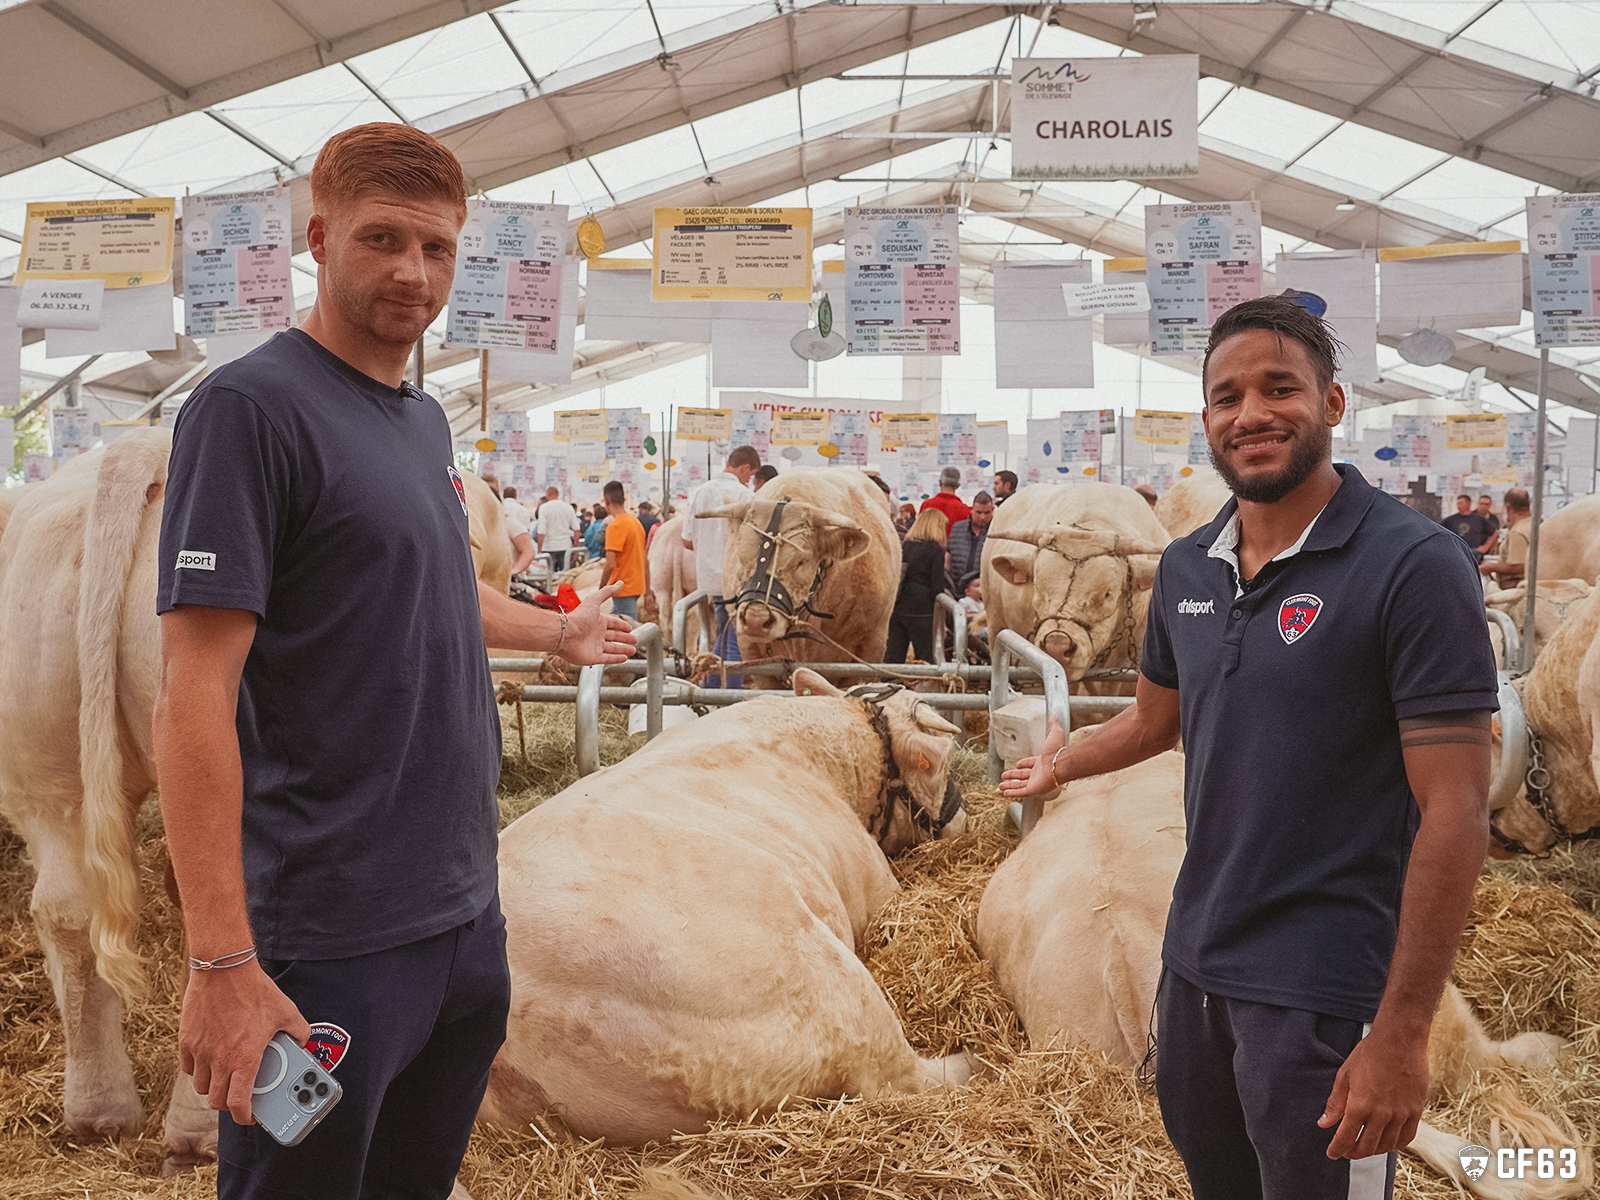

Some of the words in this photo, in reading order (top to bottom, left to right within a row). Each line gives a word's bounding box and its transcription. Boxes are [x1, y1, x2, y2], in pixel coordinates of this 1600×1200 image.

[1026, 82, 1074, 92] SOMMET
[1036, 119, 1172, 139] CHAROLAIS
[510, 203, 535, 211] CORENTIN
[223, 228, 250, 236] SICHON
[881, 245, 922, 253] SEDUISANT
[1189, 242, 1220, 250] SAFRAN
[464, 264, 500, 272] MASTERCHEF
[1178, 599, 1215, 617] uhlsport
[331, 1030, 346, 1043] FOOT
